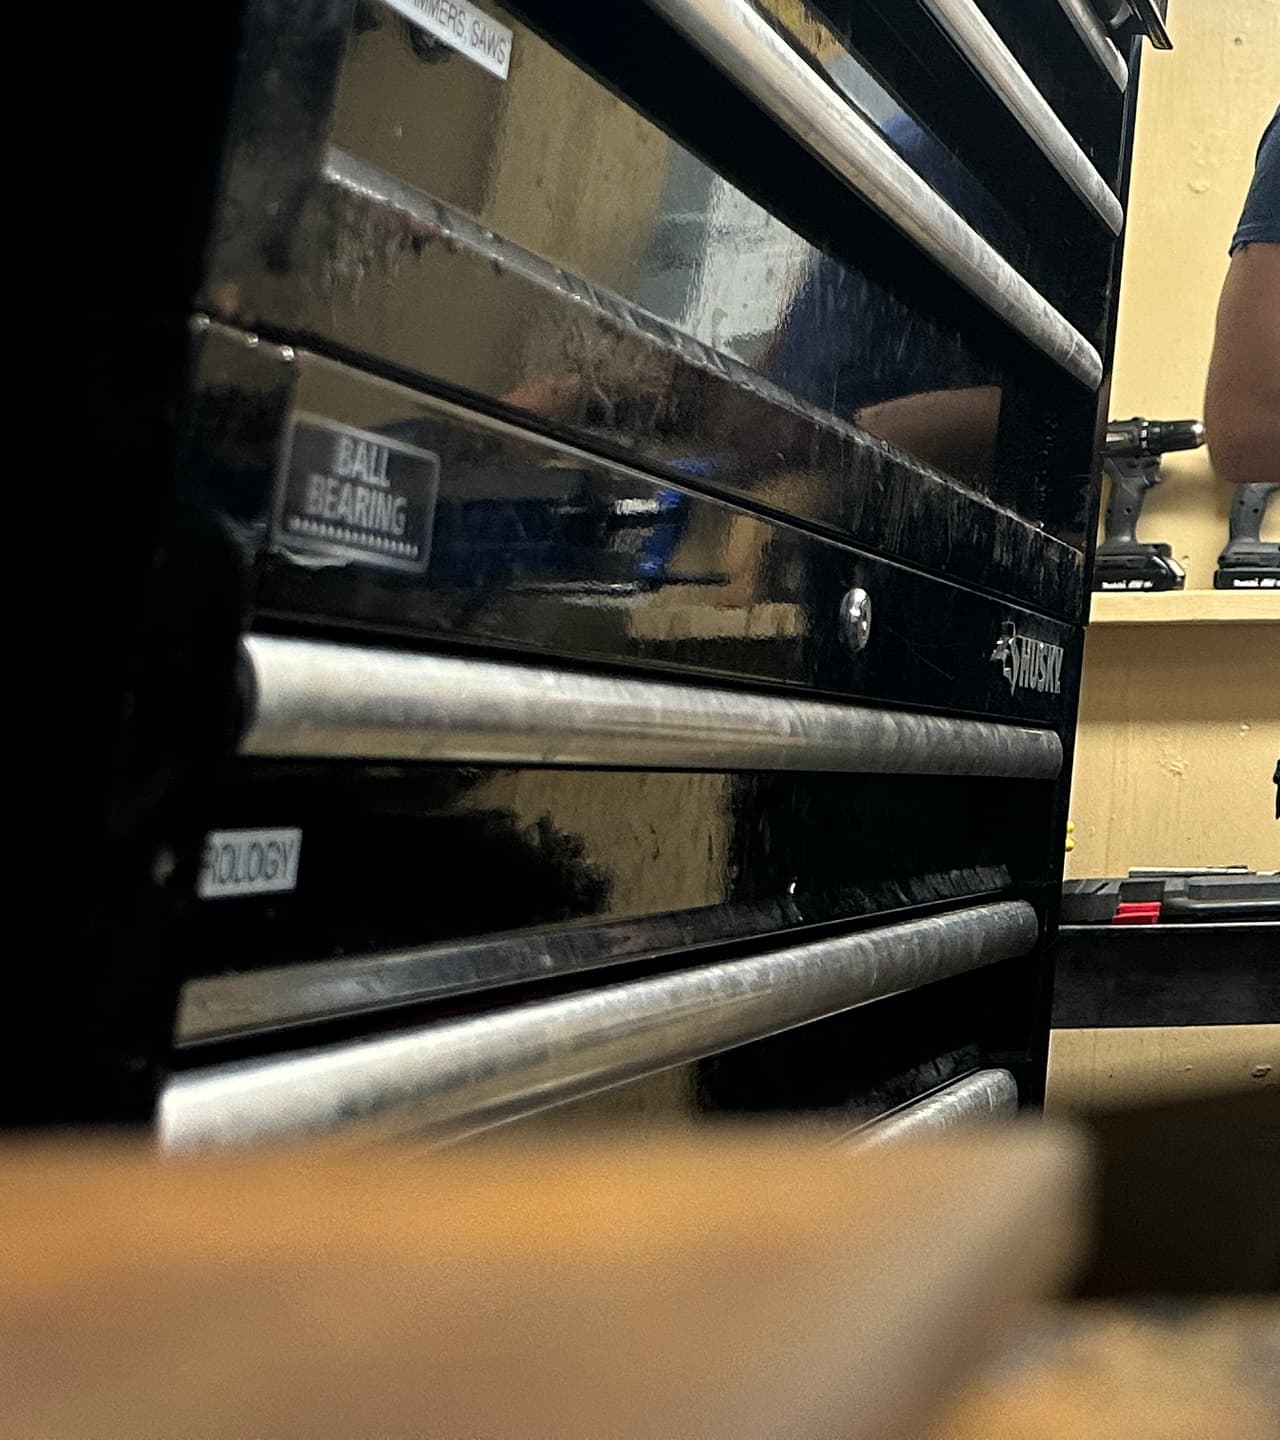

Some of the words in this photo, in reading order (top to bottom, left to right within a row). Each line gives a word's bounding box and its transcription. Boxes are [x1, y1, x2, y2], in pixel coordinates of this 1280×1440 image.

[471, 20, 508, 65] SAWS
[332, 435, 391, 487] BALL
[306, 474, 408, 536] BEARING
[1019, 637, 1064, 694] HUSKY
